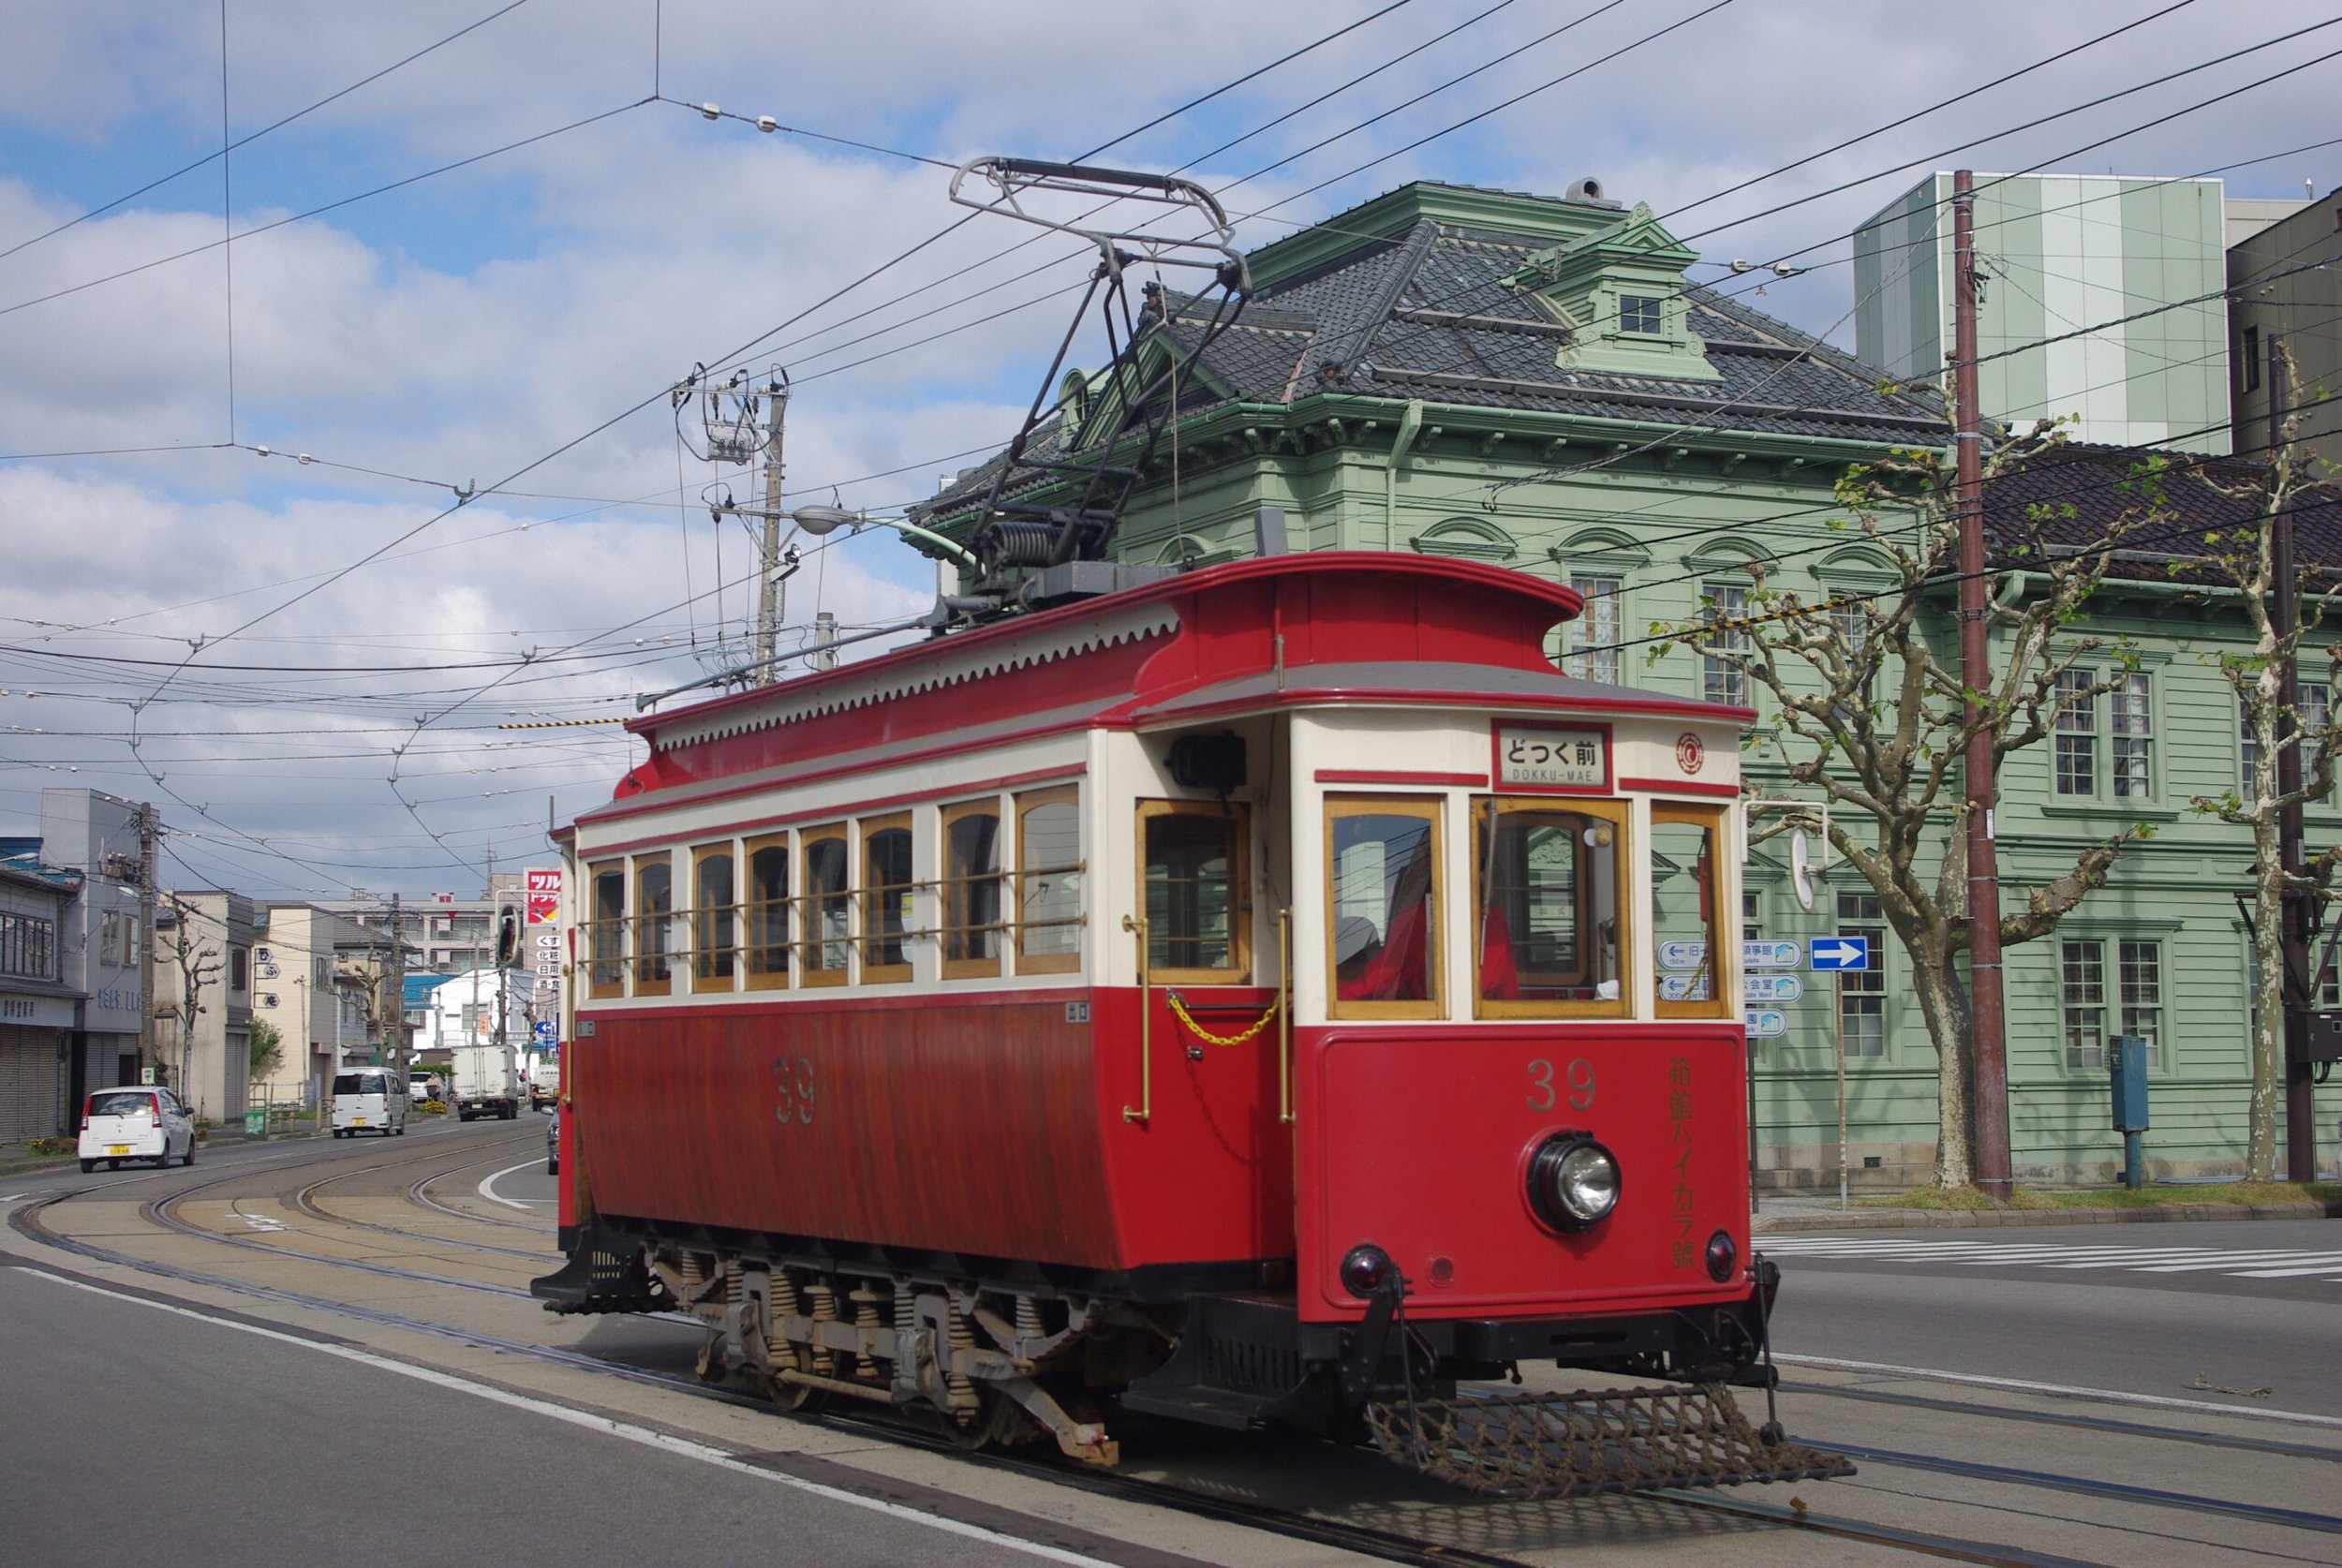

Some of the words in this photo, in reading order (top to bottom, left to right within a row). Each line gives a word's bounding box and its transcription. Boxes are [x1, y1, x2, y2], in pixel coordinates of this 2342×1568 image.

[1507, 738, 1596, 766] どつく前
[1512, 768, 1593, 782] DOKKU-MAE
[773, 1058, 814, 1124] 39
[1526, 1058, 1595, 1112] 39
